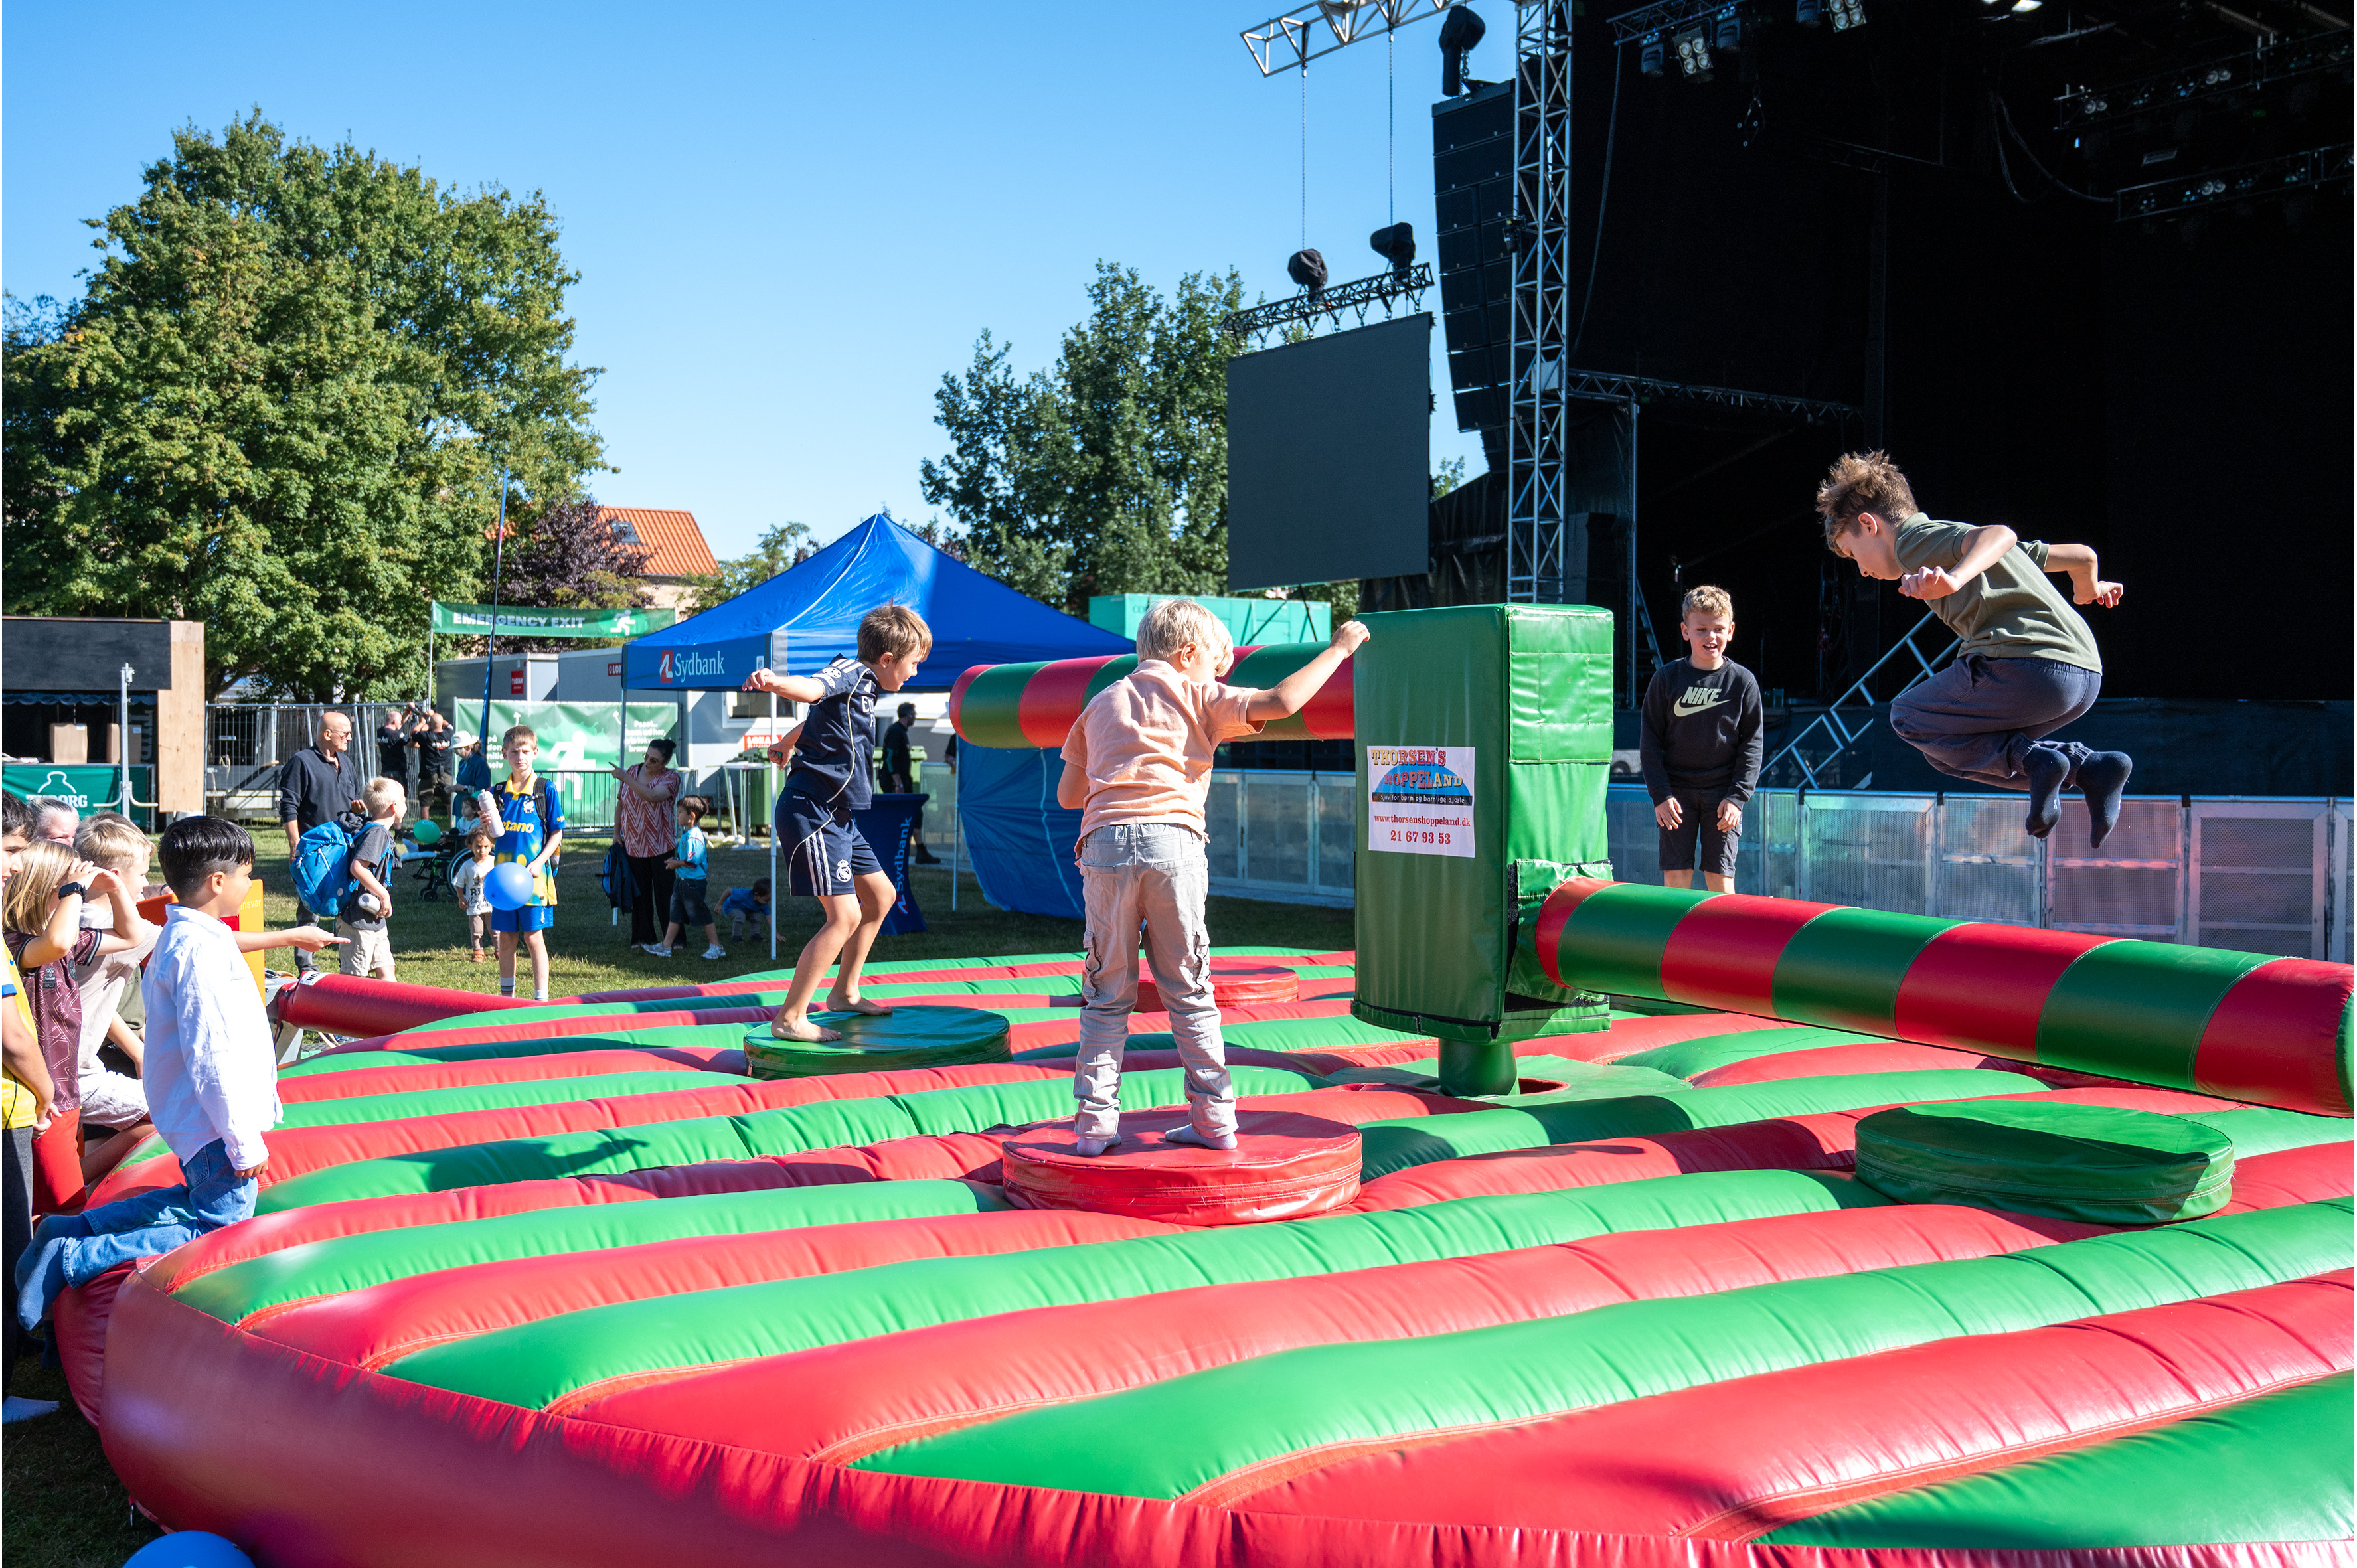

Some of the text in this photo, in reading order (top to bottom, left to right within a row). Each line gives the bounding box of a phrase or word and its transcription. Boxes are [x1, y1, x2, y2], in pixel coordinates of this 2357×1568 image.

[453, 612, 586, 628] EMERGENCY EXIT
[612, 665, 622, 674] LOX
[675, 650, 726, 683] Sydbank
[1681, 686, 1722, 705] NIKE
[747, 736, 779, 745] LOXA
[1370, 747, 1446, 767] THORSEN'S
[1384, 770, 1463, 789] HOPPELAND
[25, 795, 88, 808] TORG
[1423, 795, 1447, 804] barnlige
[501, 820, 534, 834] etano
[1374, 814, 1471, 827] www.thorsenshoppeland.dk
[1390, 830, 1451, 845] 21 67 93 53
[894, 816, 913, 892] Sydbank
